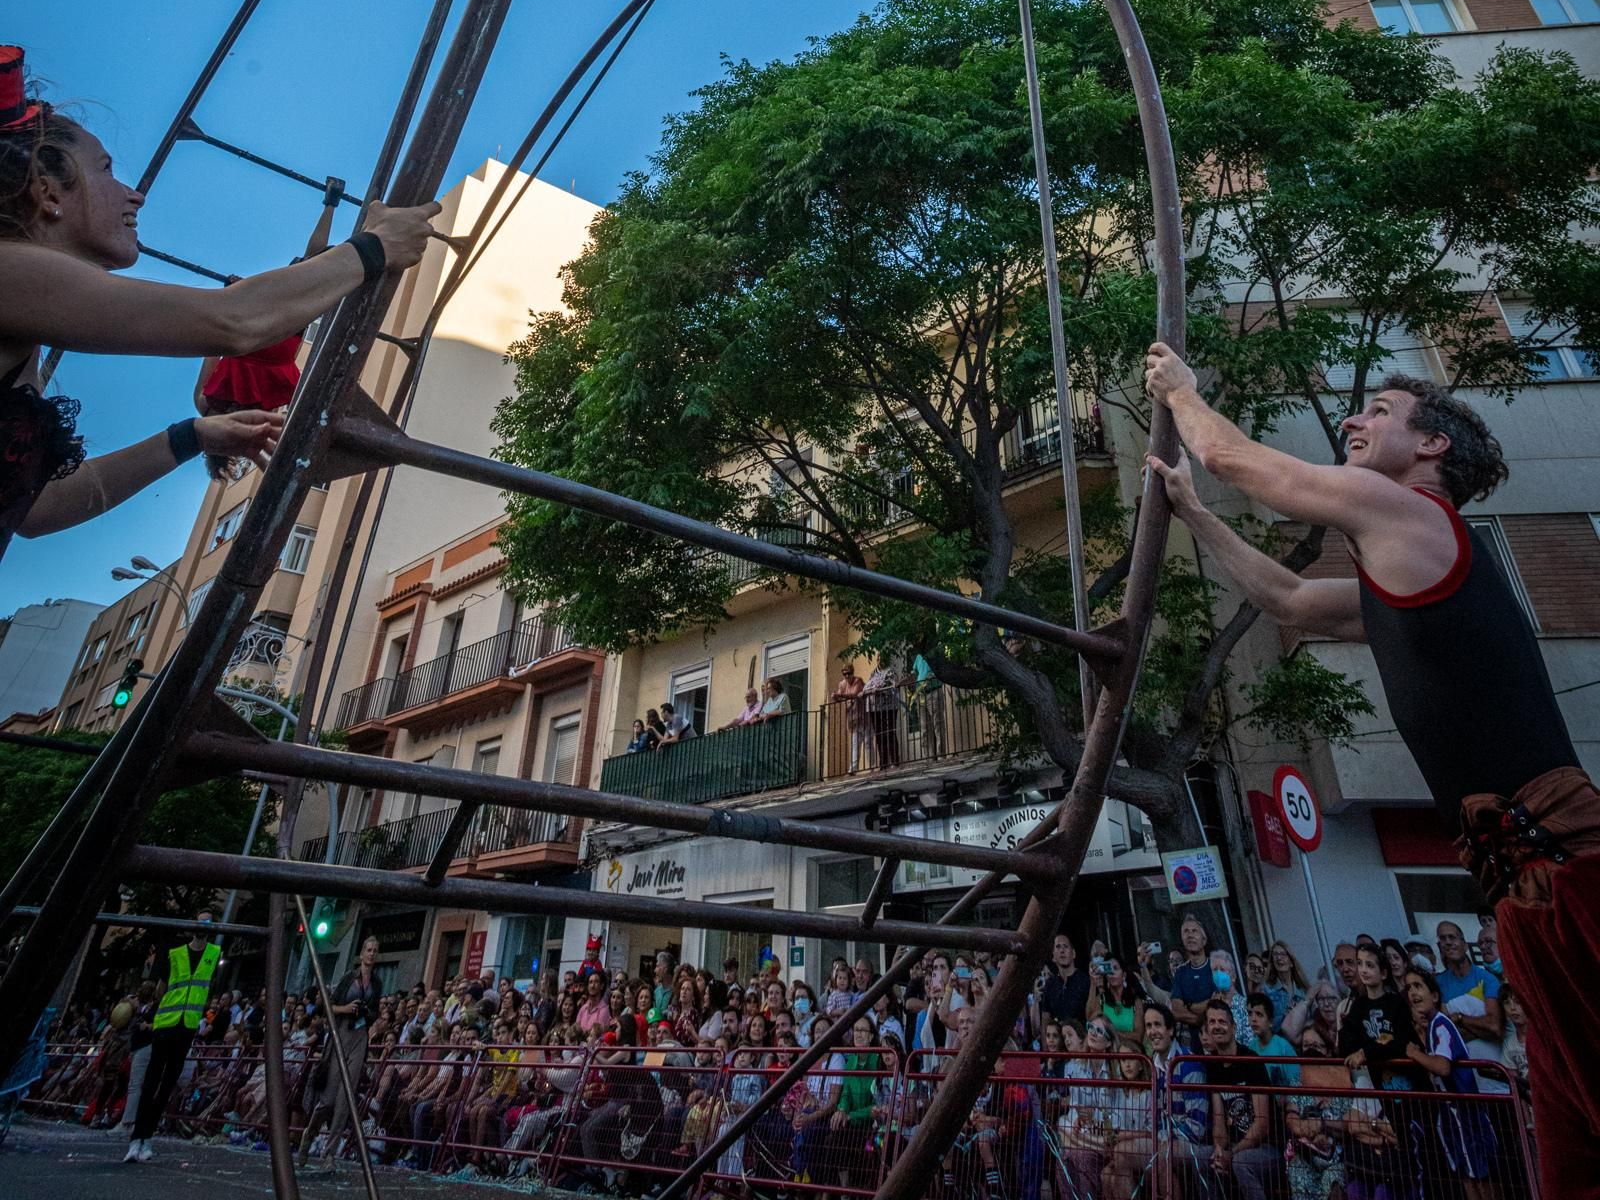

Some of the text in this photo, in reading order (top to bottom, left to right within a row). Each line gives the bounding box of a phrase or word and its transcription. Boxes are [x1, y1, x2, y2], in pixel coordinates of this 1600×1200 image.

[1286, 791, 1311, 821] 50
[990, 808, 1046, 850] ALUMINIOS
[627, 860, 686, 893] Javi Mira
